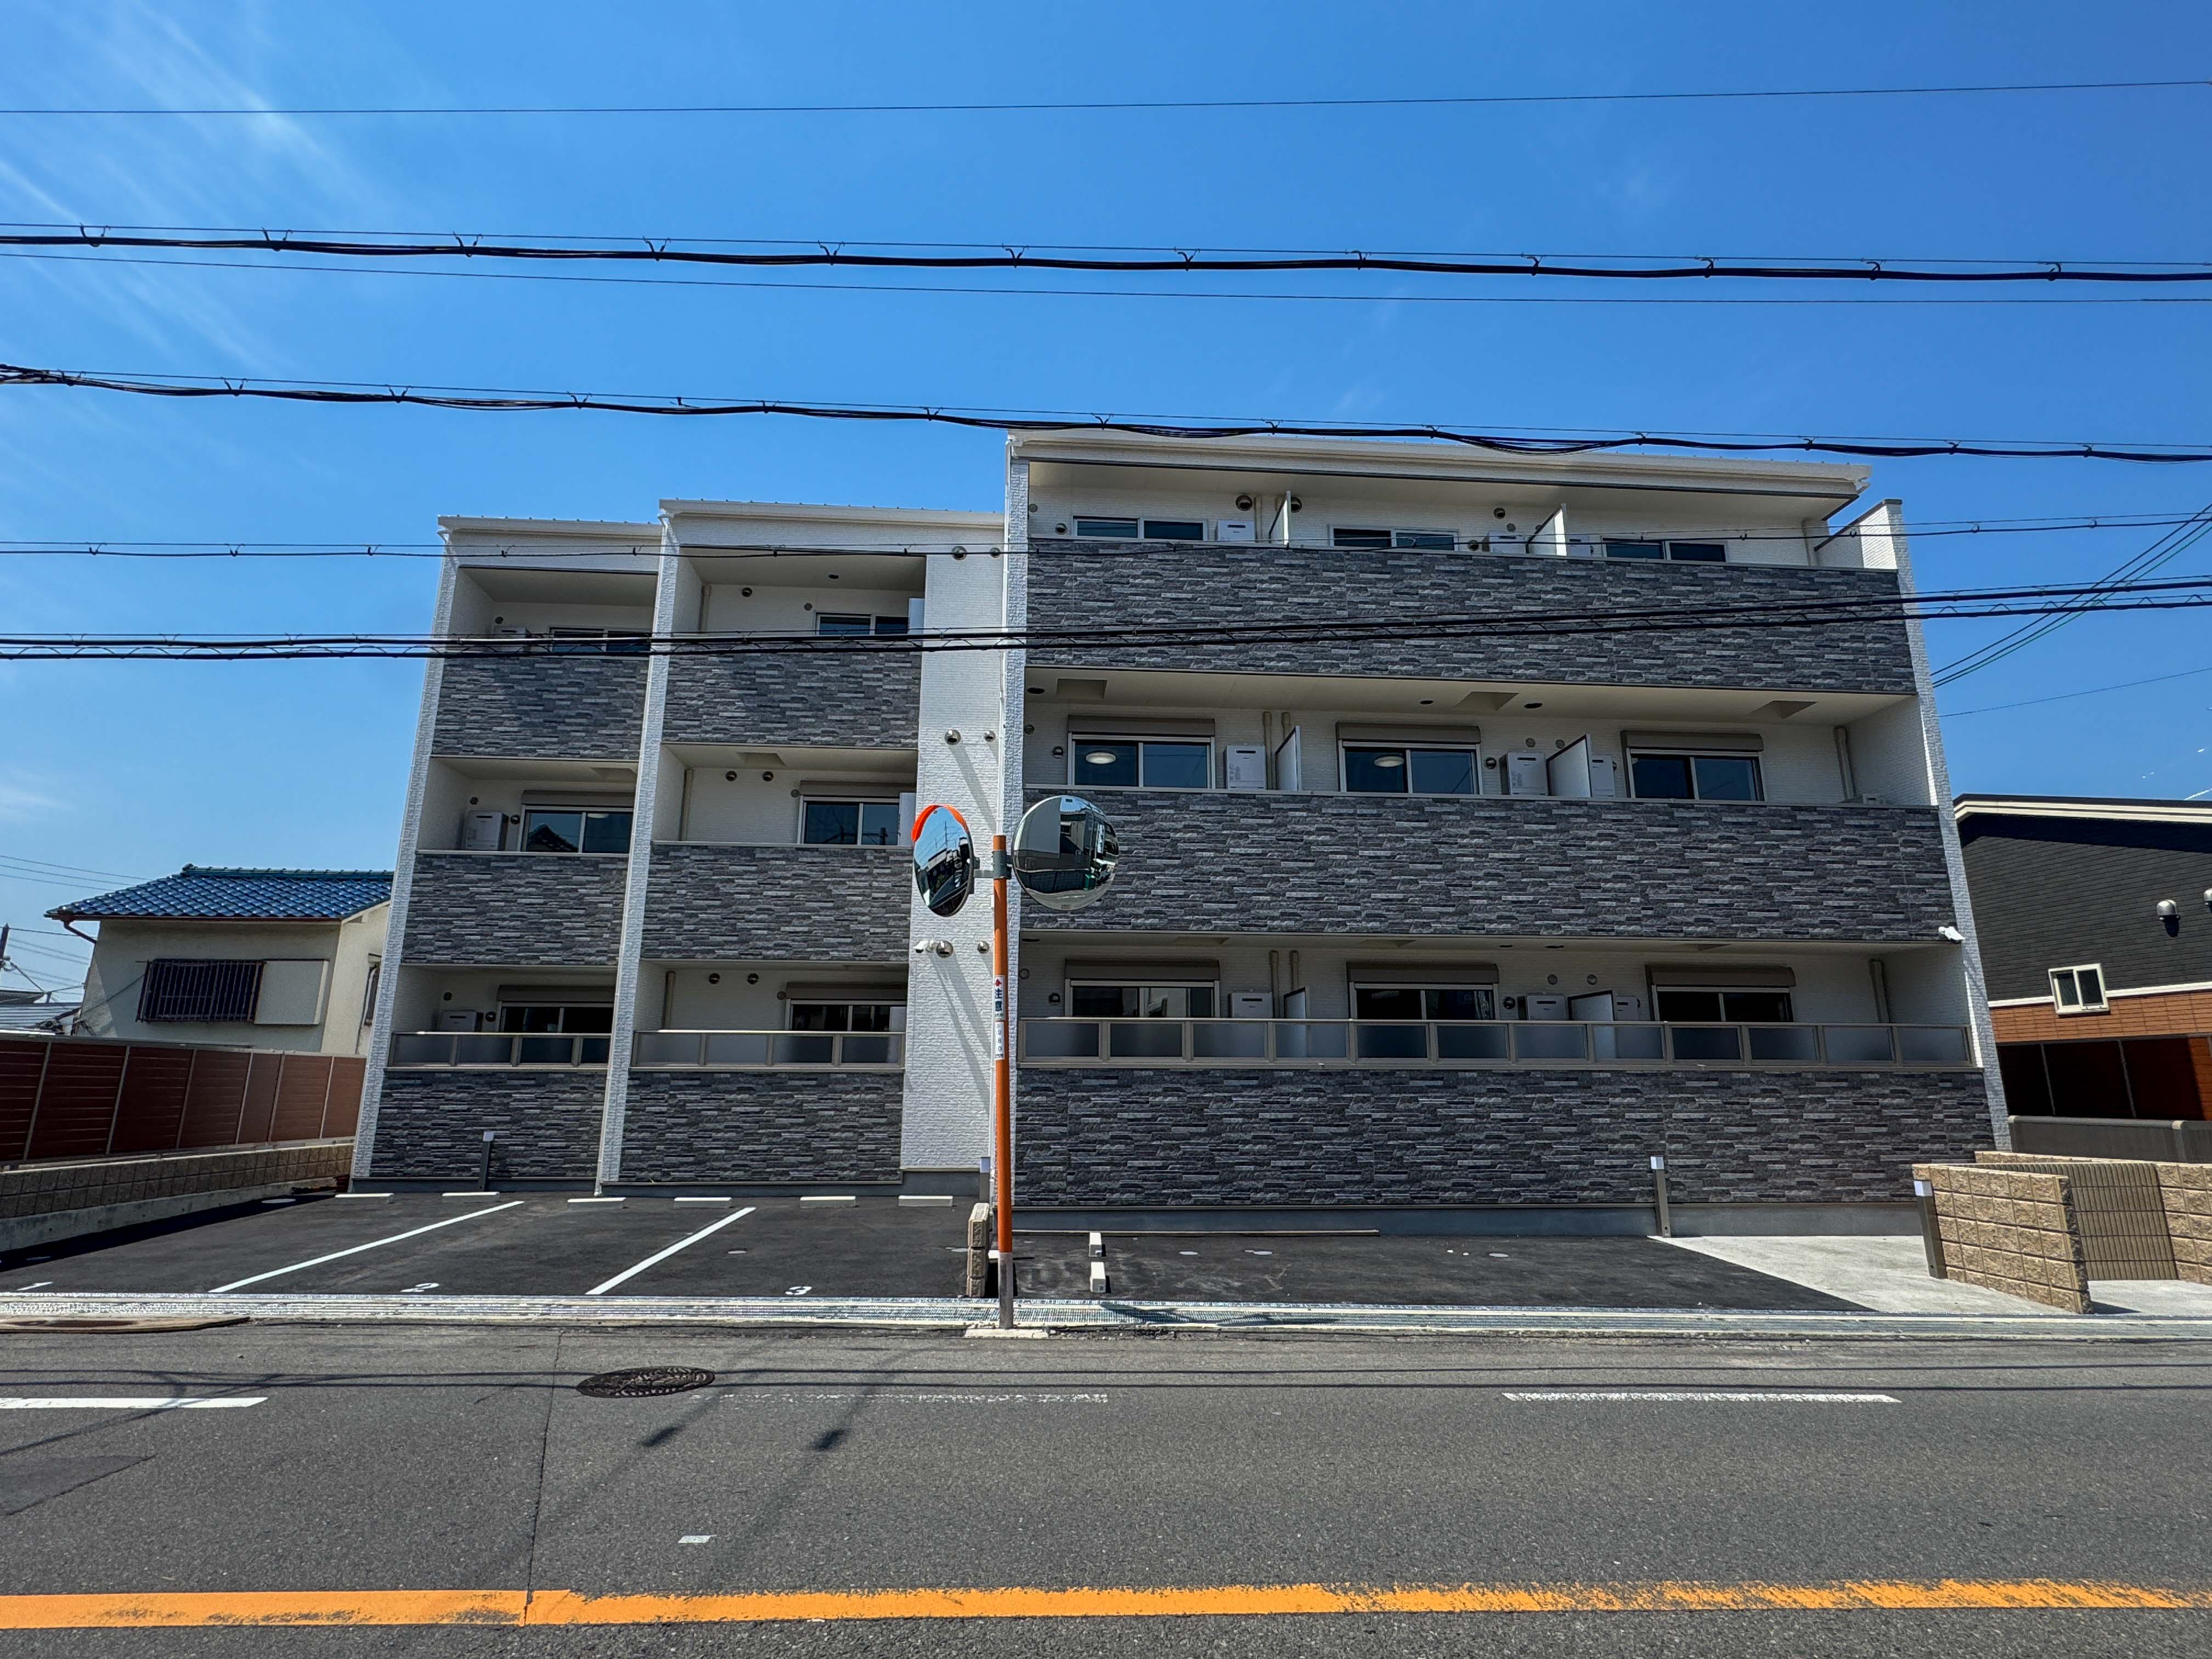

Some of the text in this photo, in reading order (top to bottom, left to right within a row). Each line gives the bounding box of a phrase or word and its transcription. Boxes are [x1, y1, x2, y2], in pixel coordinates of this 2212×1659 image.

[995, 988, 1003, 1012] 注意
[400, 1283, 439, 1293] 2
[785, 1286, 812, 1296] 3
